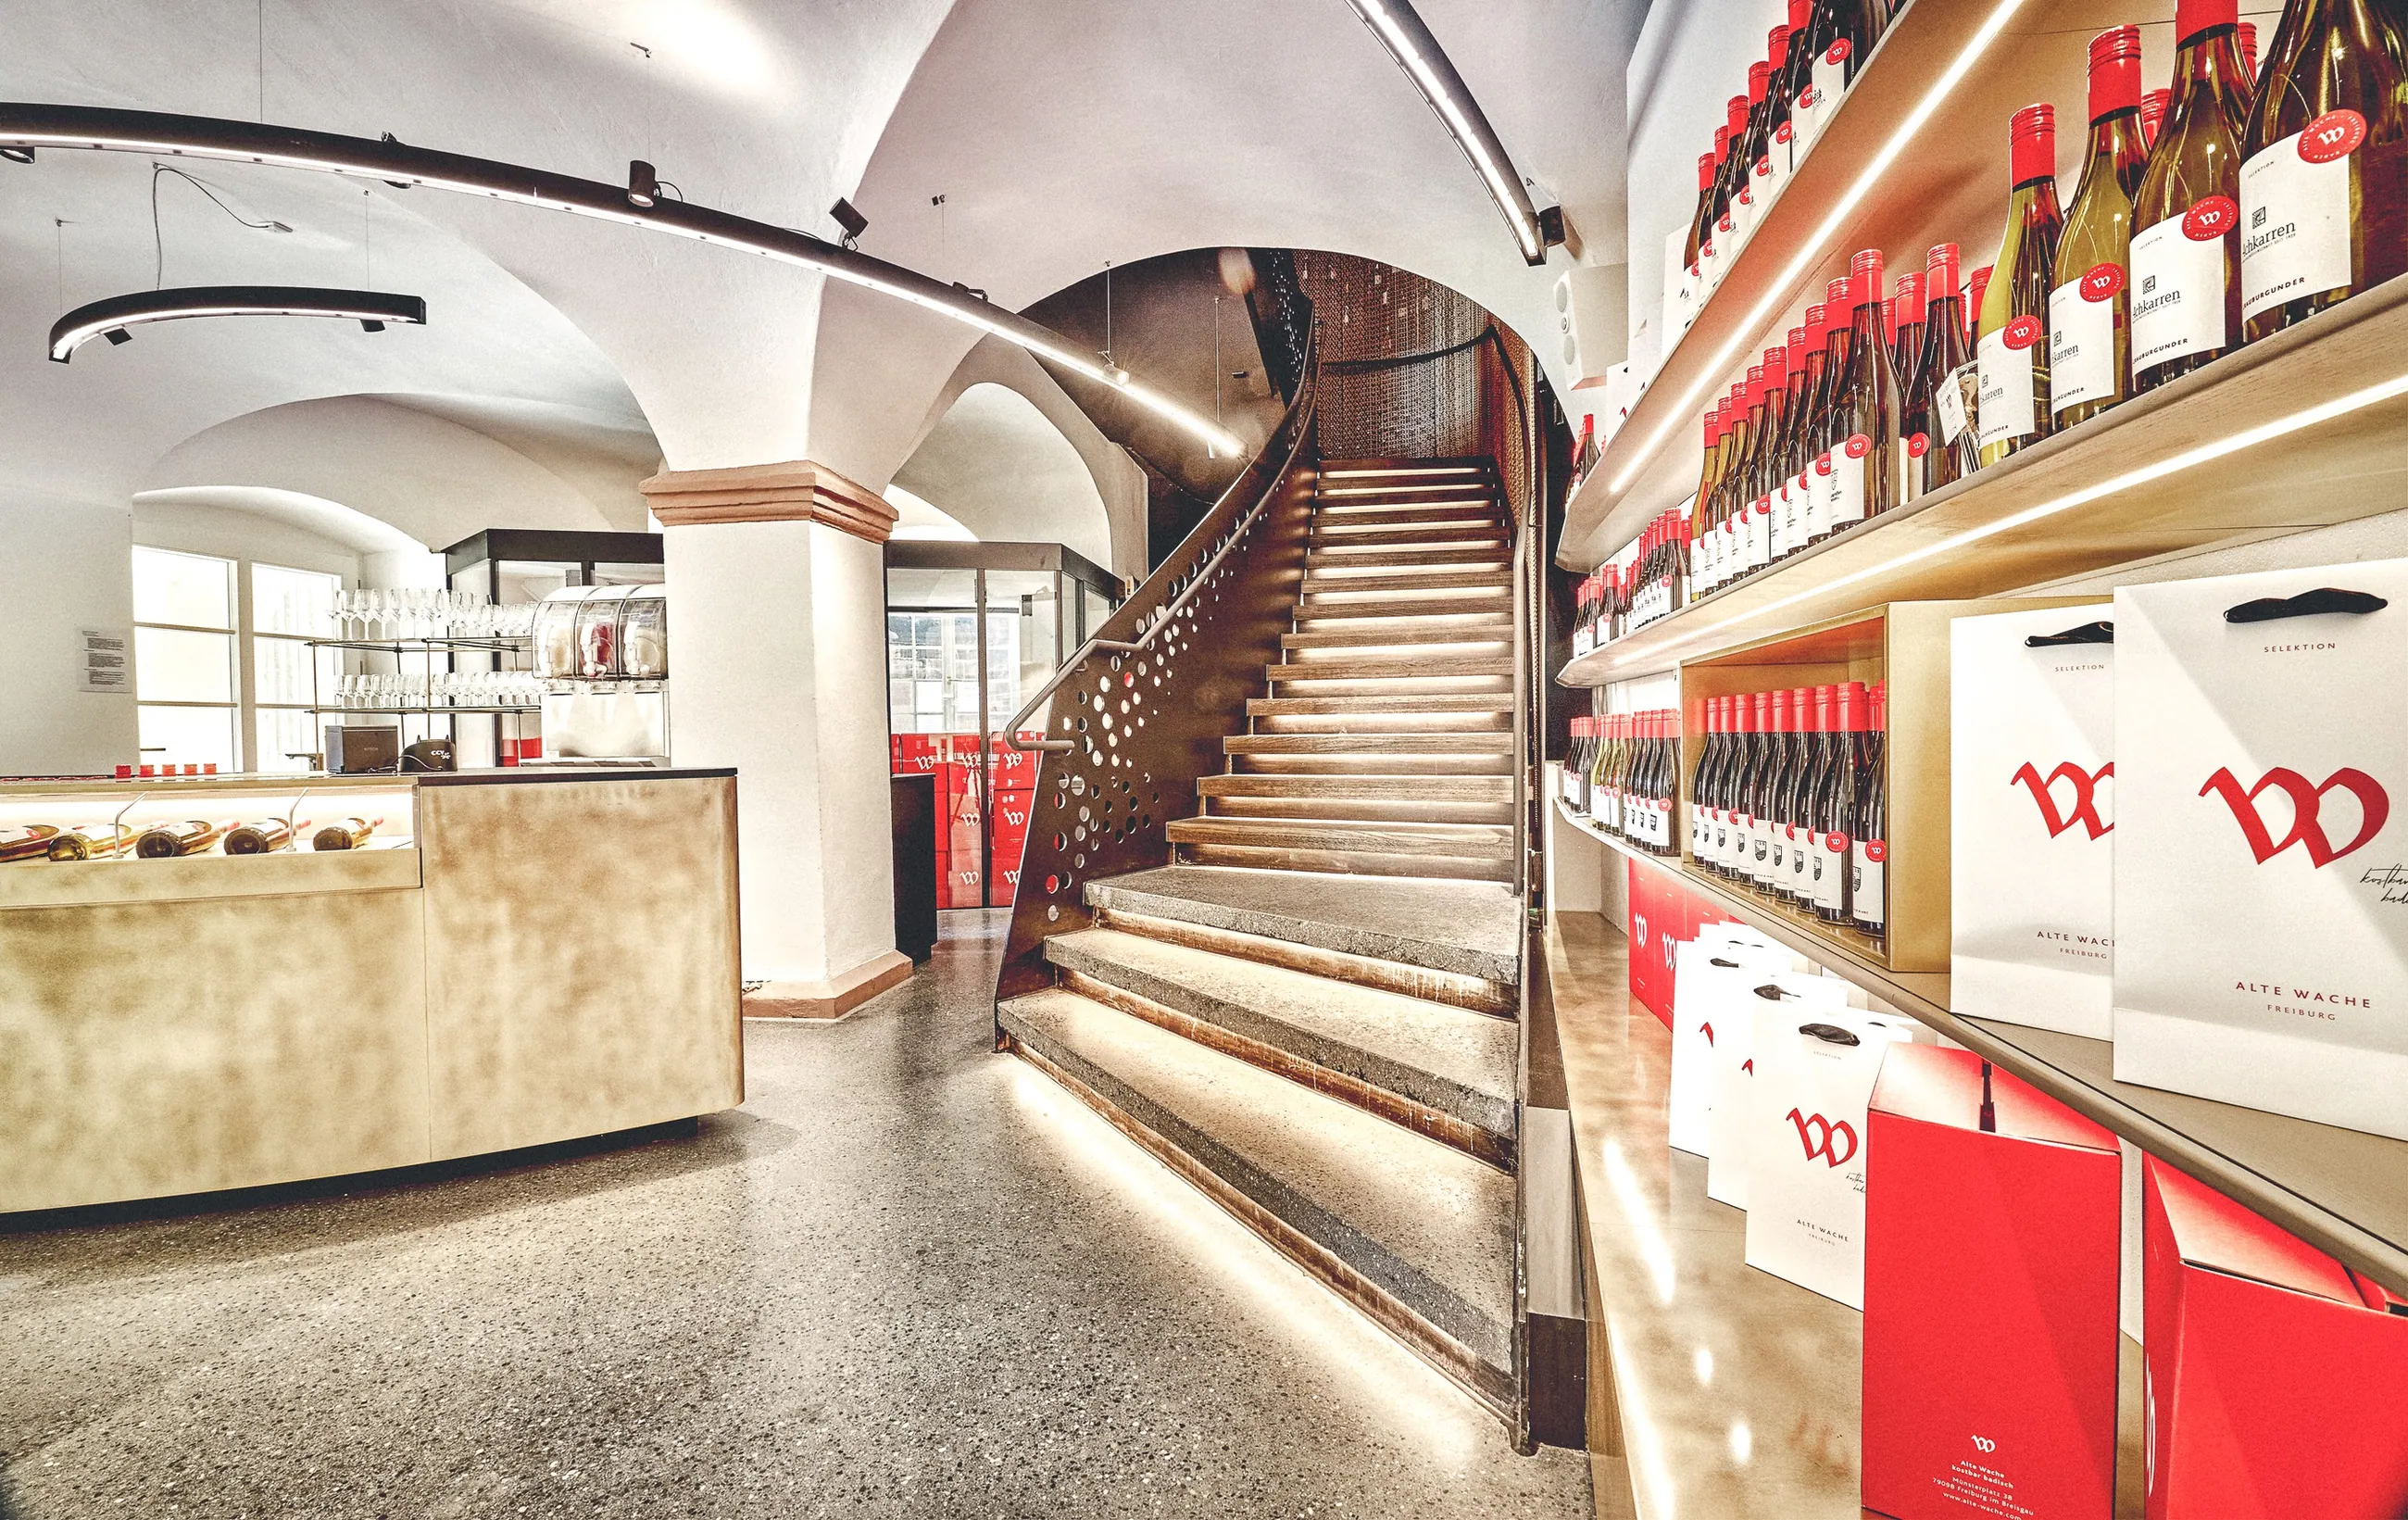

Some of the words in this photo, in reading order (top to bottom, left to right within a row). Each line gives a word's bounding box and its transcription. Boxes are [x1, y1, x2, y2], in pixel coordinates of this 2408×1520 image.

[2264, 643, 2337, 653] SELEKTION
[2055, 664, 2105, 672] SELEKTION
[2038, 931, 2069, 941] ALTE
[2060, 948, 2107, 960] FREIBURG
[2236, 982, 2282, 996] ALTE
[2294, 989, 2371, 1009] WACHE
[2267, 1005, 2336, 1021] FREIBURG
[1797, 1219, 1815, 1230] ALTE
[1819, 1226, 1849, 1242] WACHE
[1951, 1464, 1981, 1478] kostbar
[1983, 1475, 2014, 1489] badisch
[1961, 1461, 1977, 1470] Alte
[1979, 1465, 2005, 1478] Wache
[1952, 1476, 2000, 1498] Münsterplatz
[1943, 1492, 2022, 1520] www.alte-wache.com
[1957, 1486, 1988, 1502] Freiburg
[2001, 1501, 2034, 1516] Breisgau
